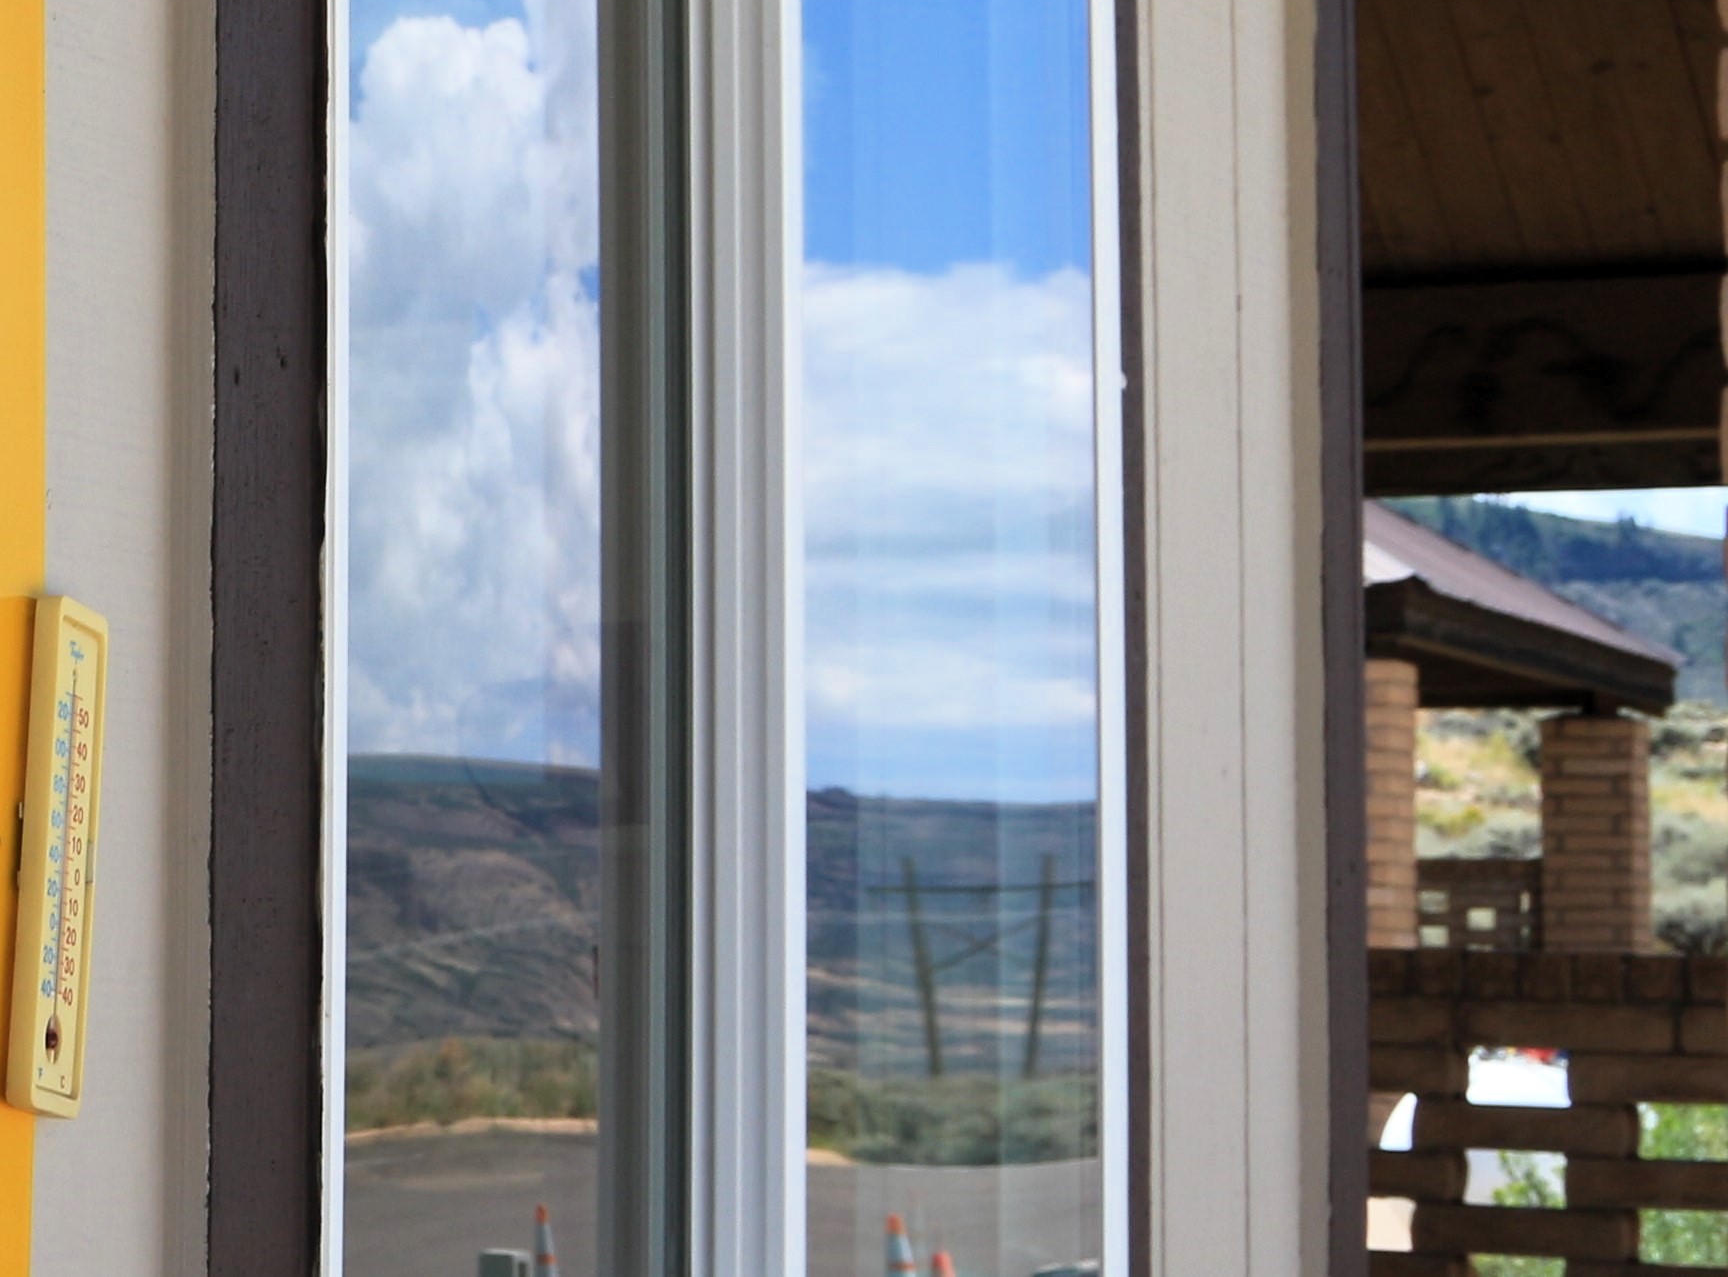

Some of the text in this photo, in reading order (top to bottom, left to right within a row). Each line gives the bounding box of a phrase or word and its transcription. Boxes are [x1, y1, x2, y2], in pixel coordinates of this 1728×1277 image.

[79, 707, 89, 729] 50
[77, 741, 88, 761] 40
[75, 773, 86, 794] 30
[73, 805, 84, 824] 20
[72, 836, 82, 855] 10
[74, 868, 81, 886] 0
[69, 897, 79, 917] 10
[66, 926, 77, 946] 20
[65, 955, 75, 976] 30
[62, 986, 73, 1006] 40
